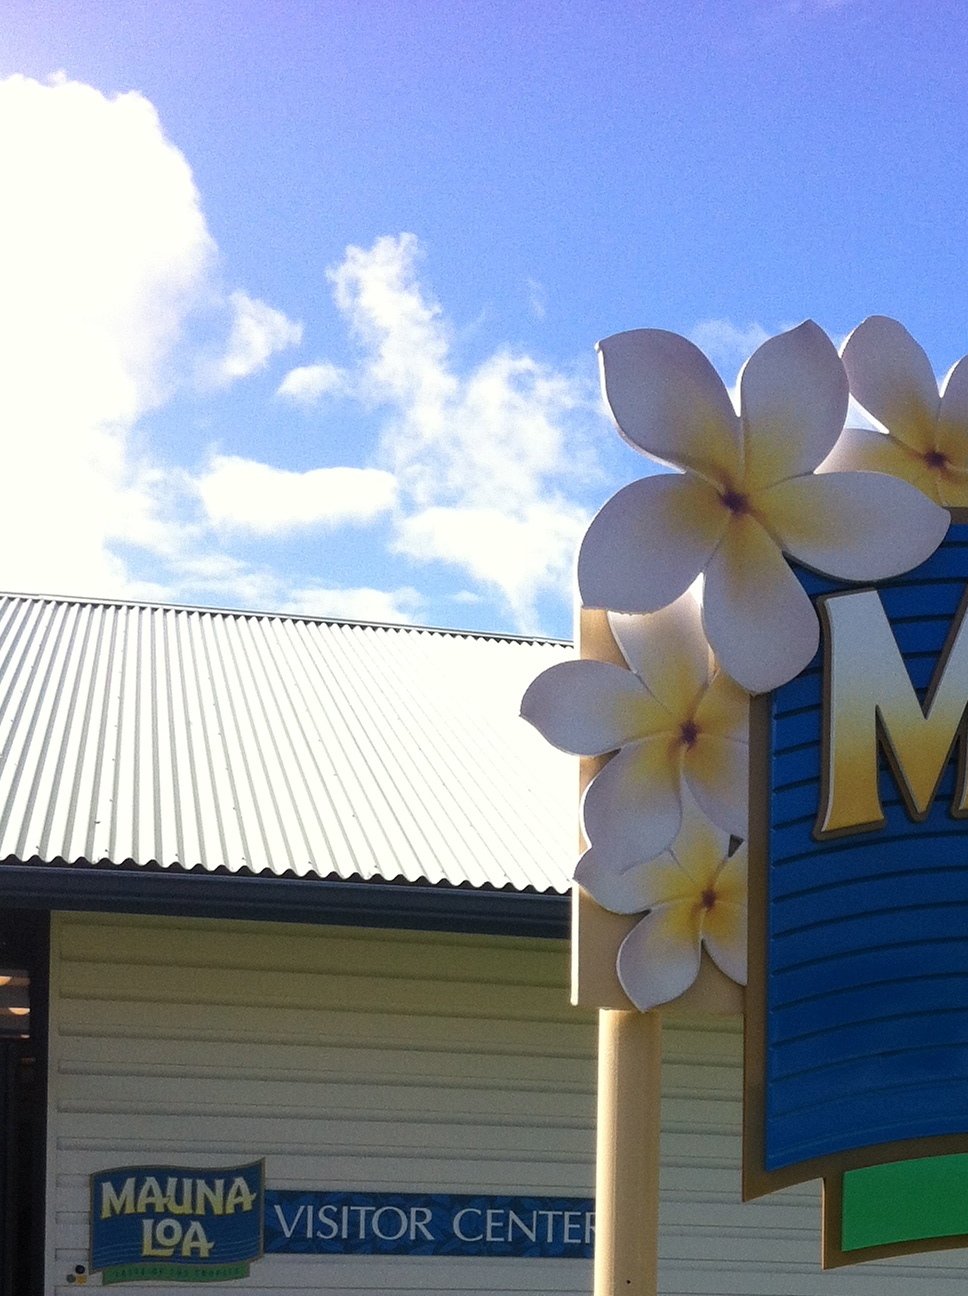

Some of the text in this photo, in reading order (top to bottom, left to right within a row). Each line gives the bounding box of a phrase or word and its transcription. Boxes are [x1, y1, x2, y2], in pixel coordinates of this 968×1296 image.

[101, 1177, 257, 1219] MAUNA
[142, 1218, 215, 1258] LOA
[273, 1204, 435, 1241] VISITOR
